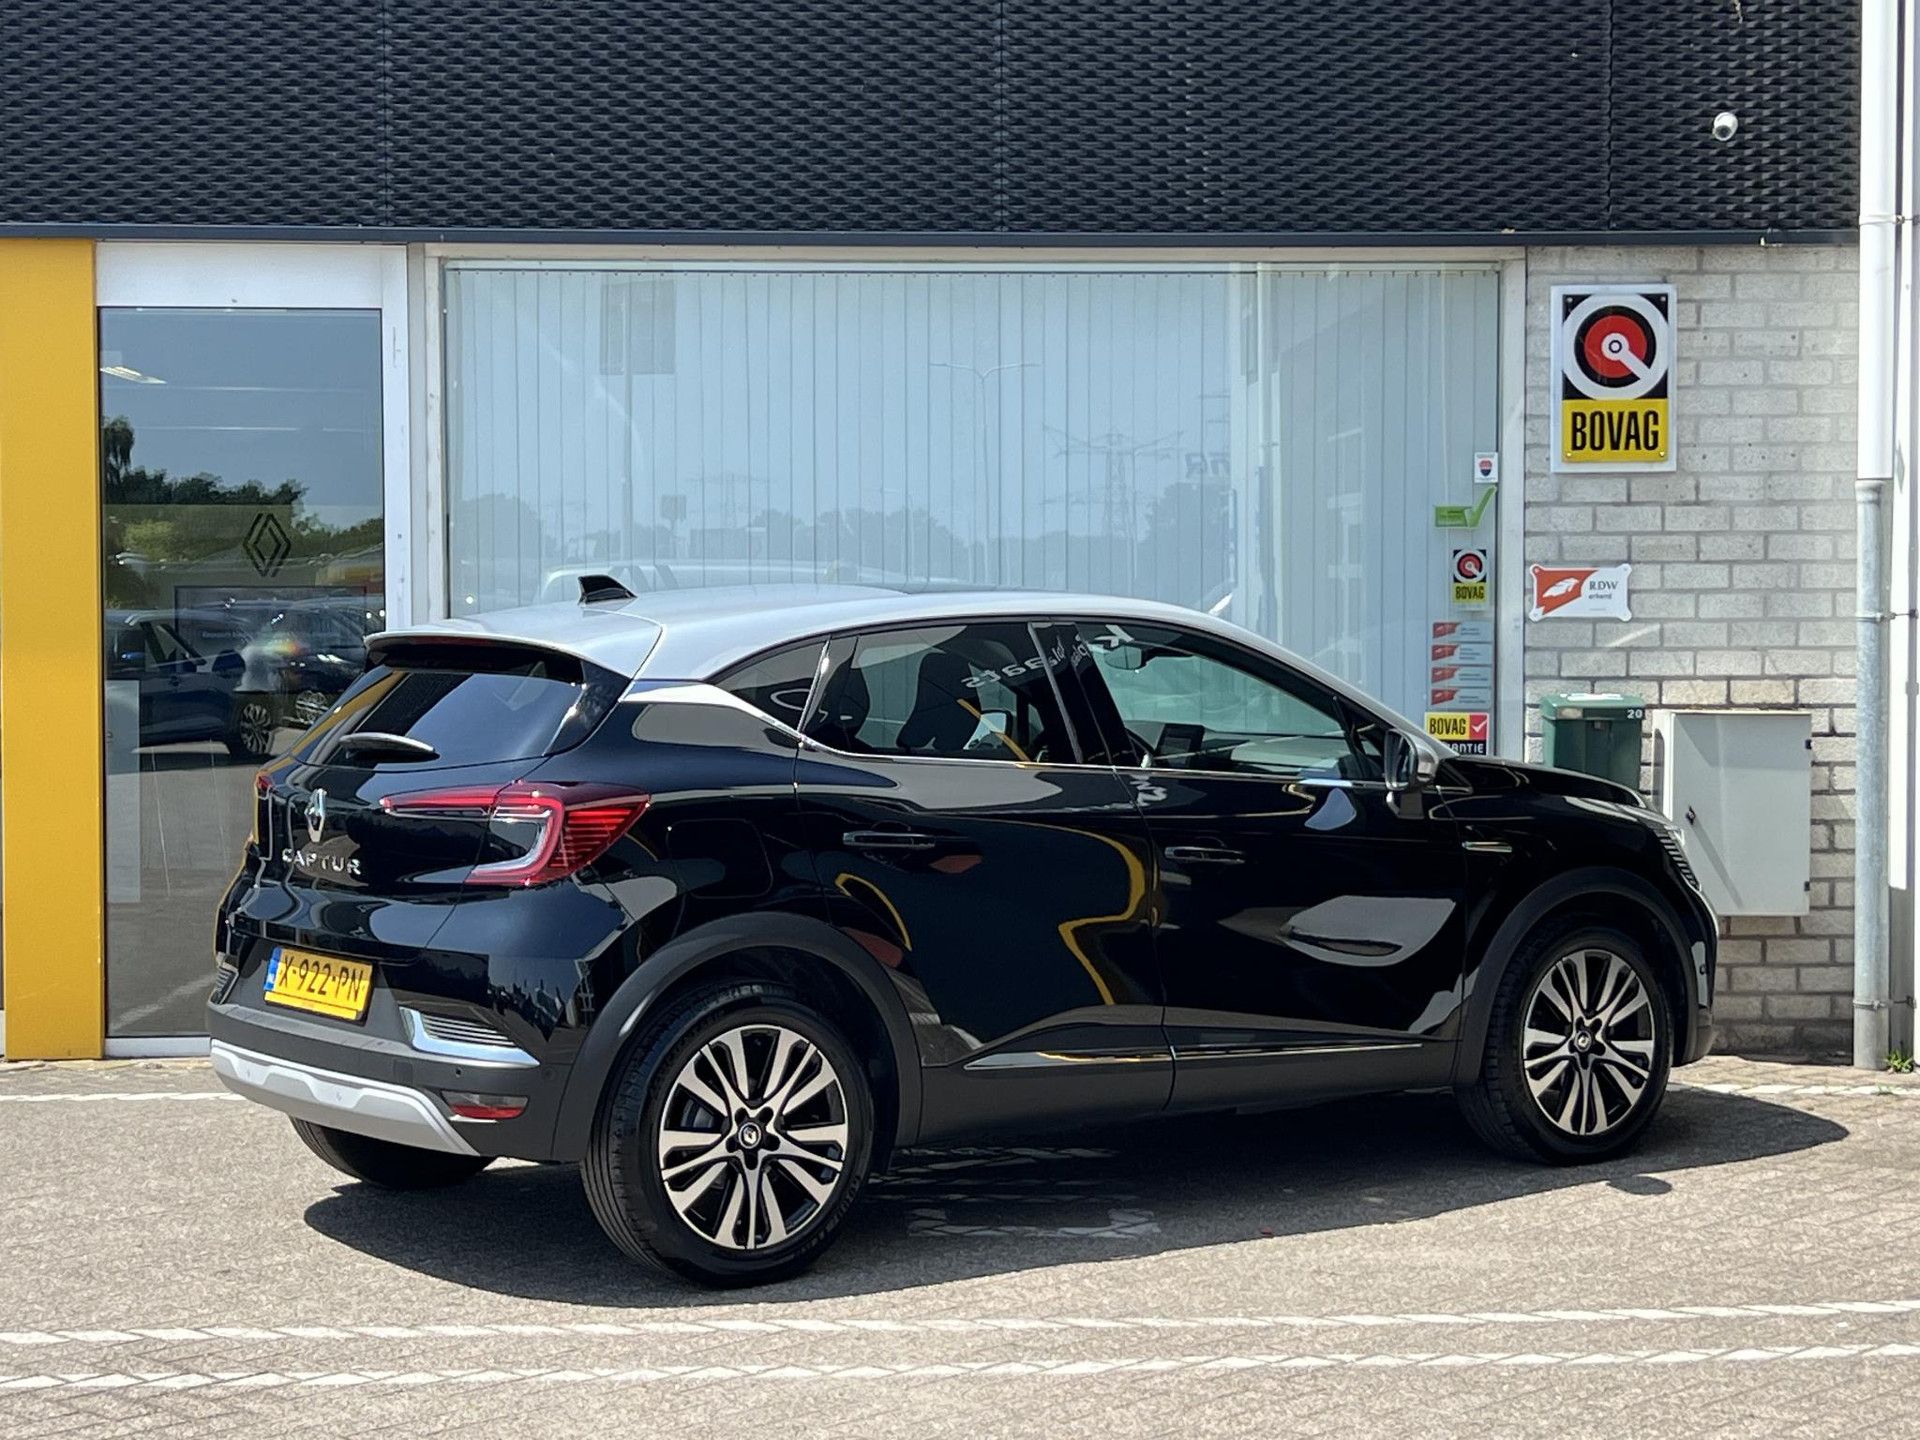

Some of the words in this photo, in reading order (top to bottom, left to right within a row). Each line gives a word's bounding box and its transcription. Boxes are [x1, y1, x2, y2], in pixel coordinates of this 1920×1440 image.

[1571, 410, 1659, 451] BOVAG
[1455, 584, 1485, 600] BOVAG
[1589, 580, 1619, 590] RDW
[1627, 709, 1643, 719] 20
[1429, 718, 1467, 735] BOVAG
[1447, 743, 1484, 754] ANTIE
[281, 848, 362, 875] CAPTUR
[277, 955, 364, 1003] X-922-PN
